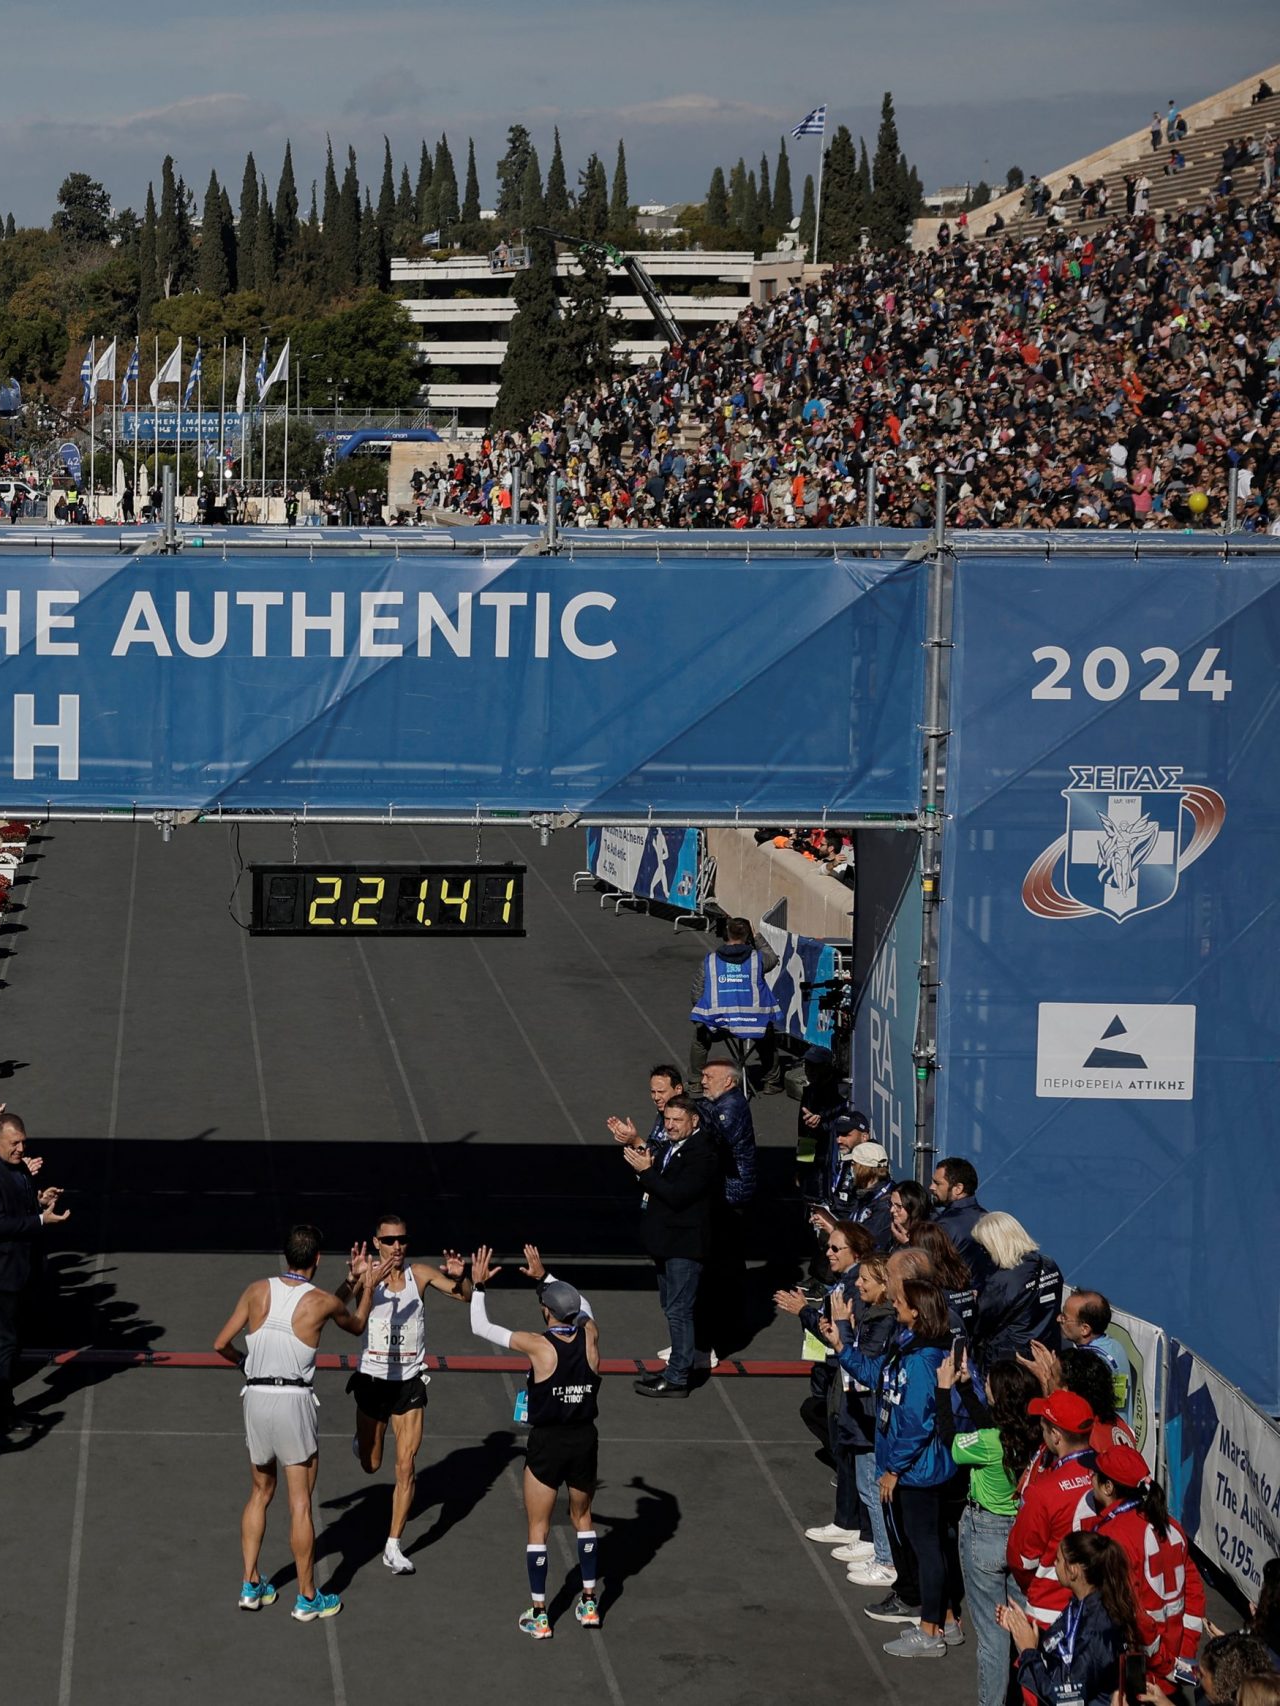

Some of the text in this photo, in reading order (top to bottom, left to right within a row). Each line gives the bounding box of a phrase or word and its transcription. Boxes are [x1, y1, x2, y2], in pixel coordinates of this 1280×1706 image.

[185, 418, 241, 426] MARATON
[67, 457, 80, 466] 42
[111, 591, 618, 660] AUTHENTIC
[1030, 645, 1233, 702] 2024
[1067, 765, 1184, 791] ΣΕΓΑΣ
[308, 876, 515, 926] 2.21.41
[1043, 1078, 1186, 1091] ΠΕΡΙΦΕΡΕΙΑ ΑΤΤΙΚΗΣ
[383, 1334, 405, 1346] 102
[1058, 1474, 1092, 1492] HELLENIC
[1216, 1471, 1238, 1514] The
[1260, 1472, 1272, 1506] to
